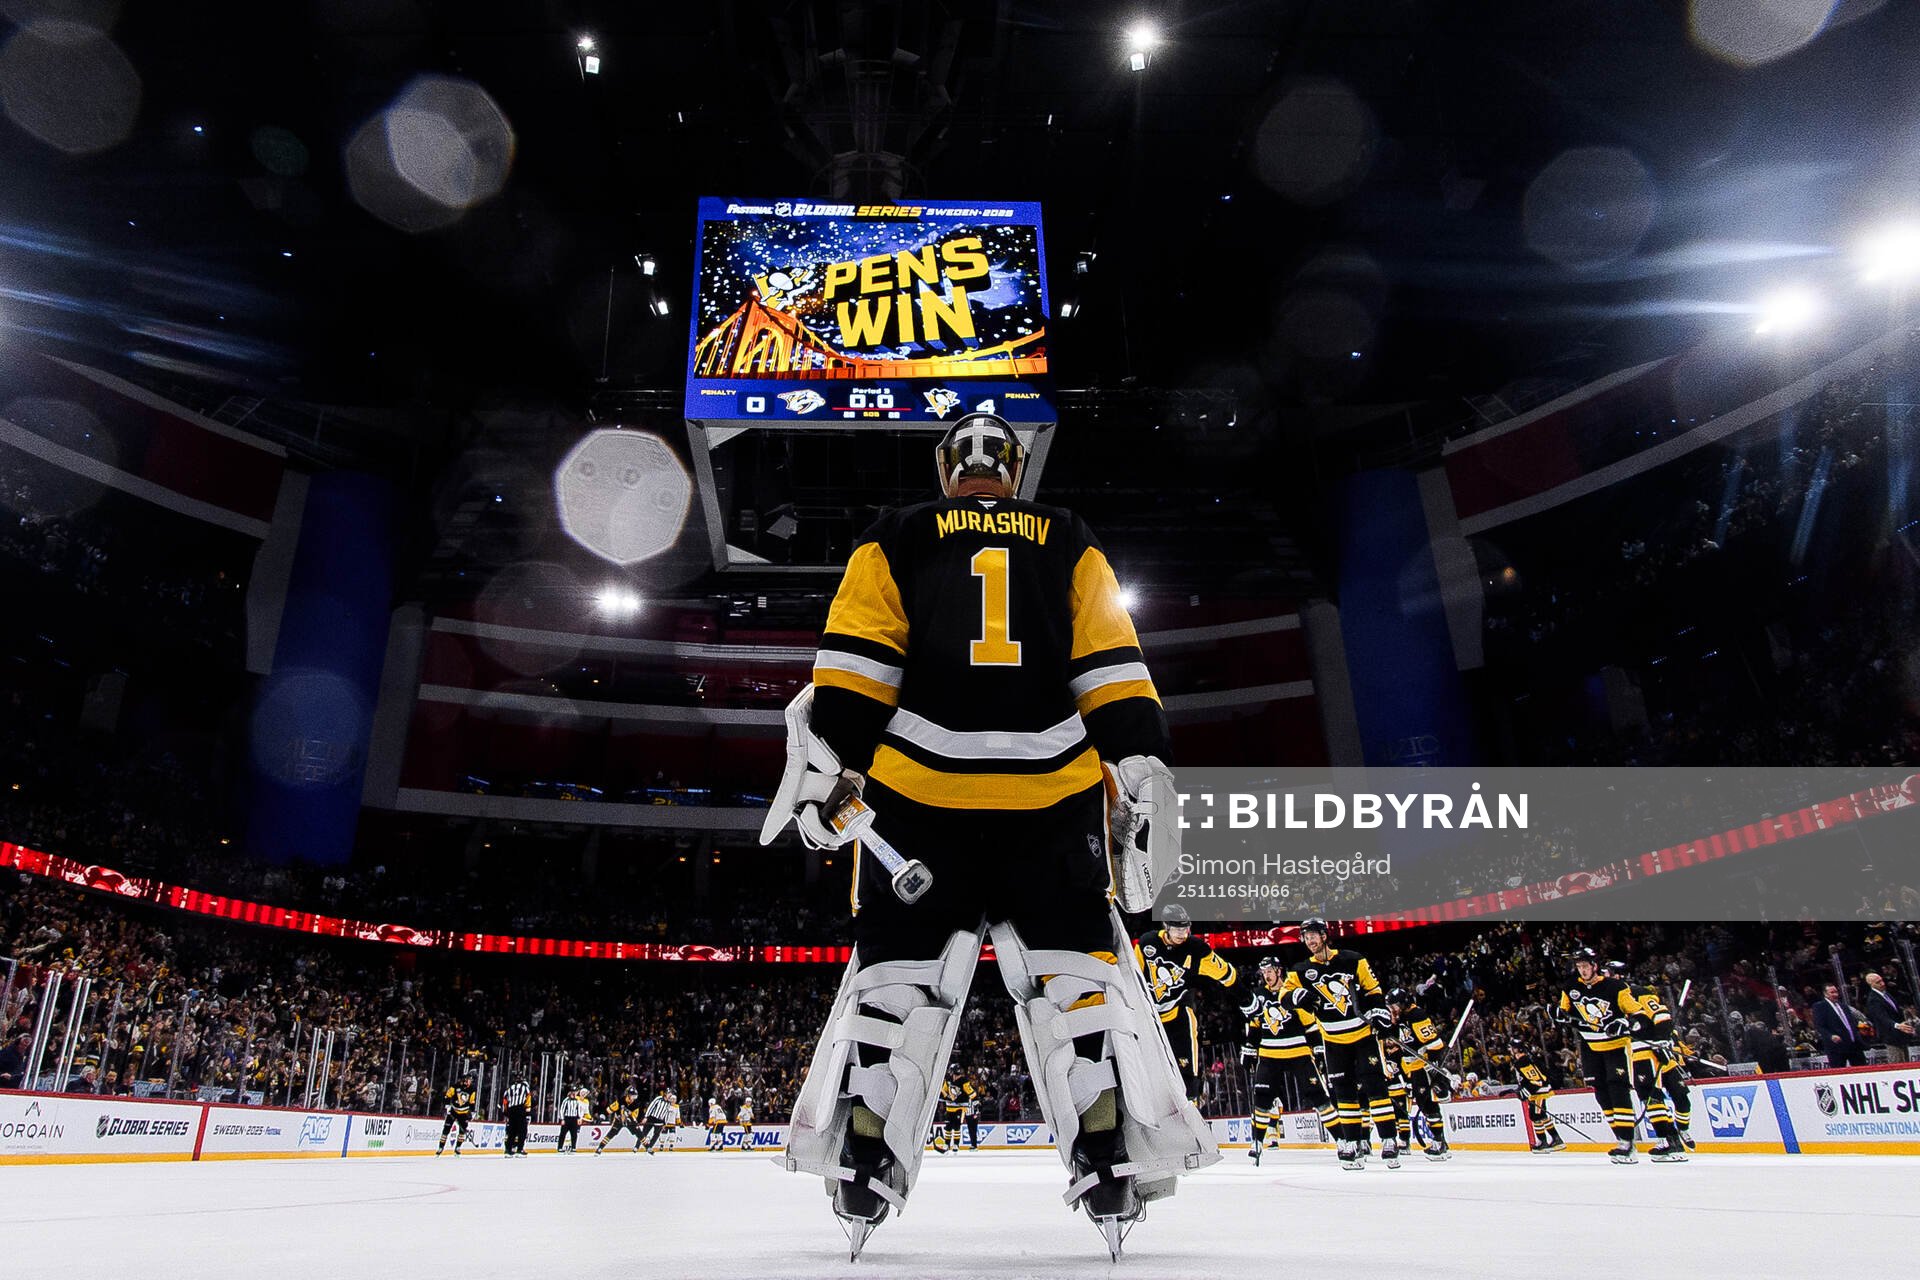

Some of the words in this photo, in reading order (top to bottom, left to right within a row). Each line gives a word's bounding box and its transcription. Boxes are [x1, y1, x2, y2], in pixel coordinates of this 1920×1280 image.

[793, 203, 856, 217] GLOBAL
[857, 206, 922, 217] SERIES
[823, 236, 990, 301] PENS
[836, 285, 976, 348] WIN
[746, 396, 766, 413] 0
[849, 394, 894, 408] 0.0
[976, 399, 996, 415] 4
[936, 509, 1051, 545] MURASHOV
[970, 546, 1022, 666] 1
[1840, 1082, 1890, 1115] NHL
[1706, 1094, 1748, 1129] SAP
[107, 1117, 150, 1136] GLOBAL
[149, 1120, 189, 1136] SERIES
[364, 1118, 392, 1136] UNIBET
[1457, 1115, 1485, 1129] GLOBAL
[1485, 1114, 1516, 1127] SERIES
[0, 1123, 65, 1139] ORQAIN
[1007, 1128, 1033, 1140] SAP
